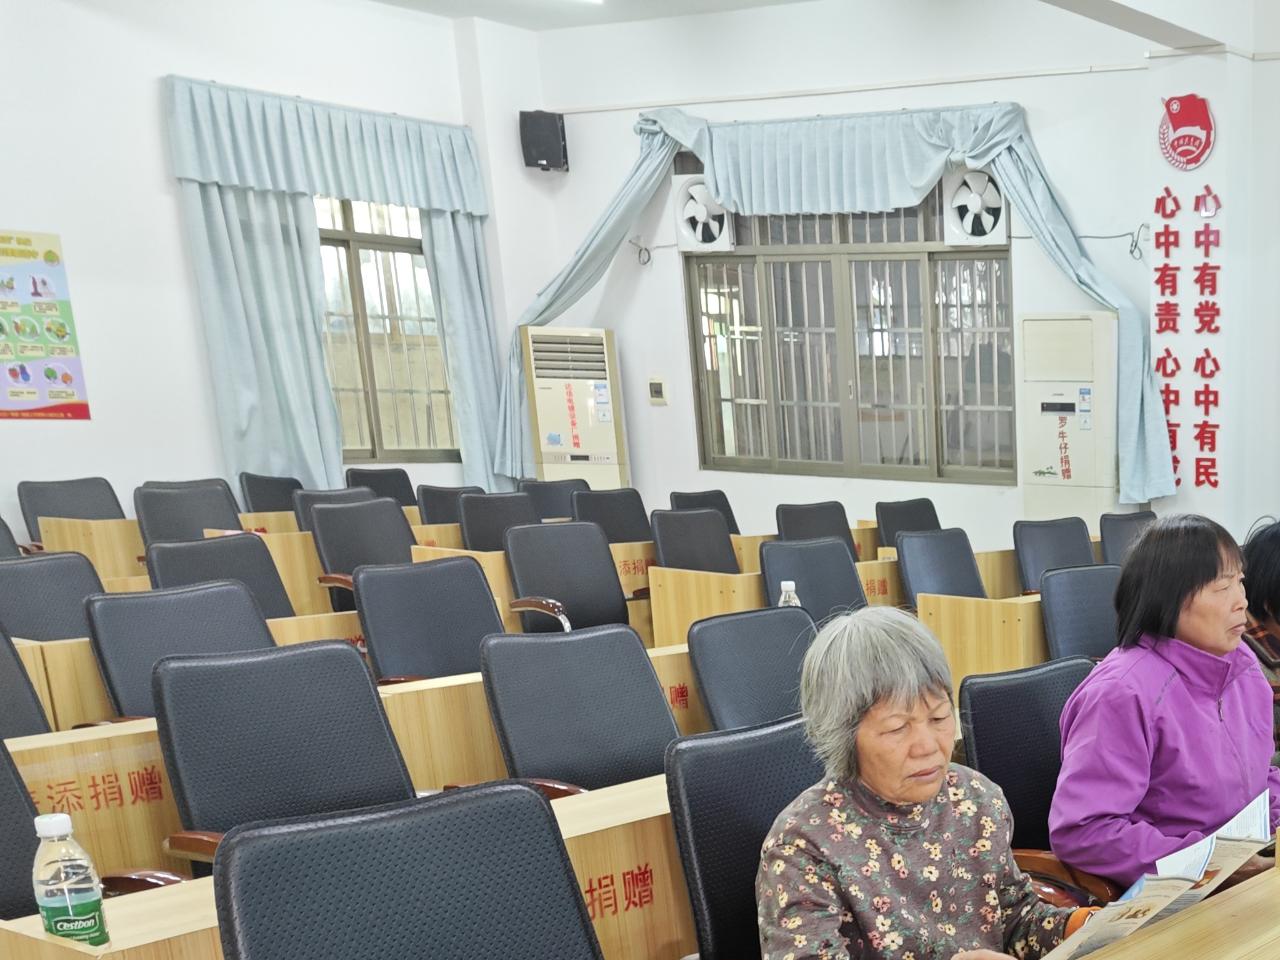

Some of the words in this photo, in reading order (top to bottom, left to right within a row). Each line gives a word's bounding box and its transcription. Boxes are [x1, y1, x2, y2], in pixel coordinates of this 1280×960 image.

[1154, 185, 1181, 335] 心中有责
[1193, 184, 1222, 335] 心中有党
[1154, 347, 1182, 488] 心中
[1193, 347, 1222, 489] 心中有民
[584, 863, 654, 920] 捐赠
